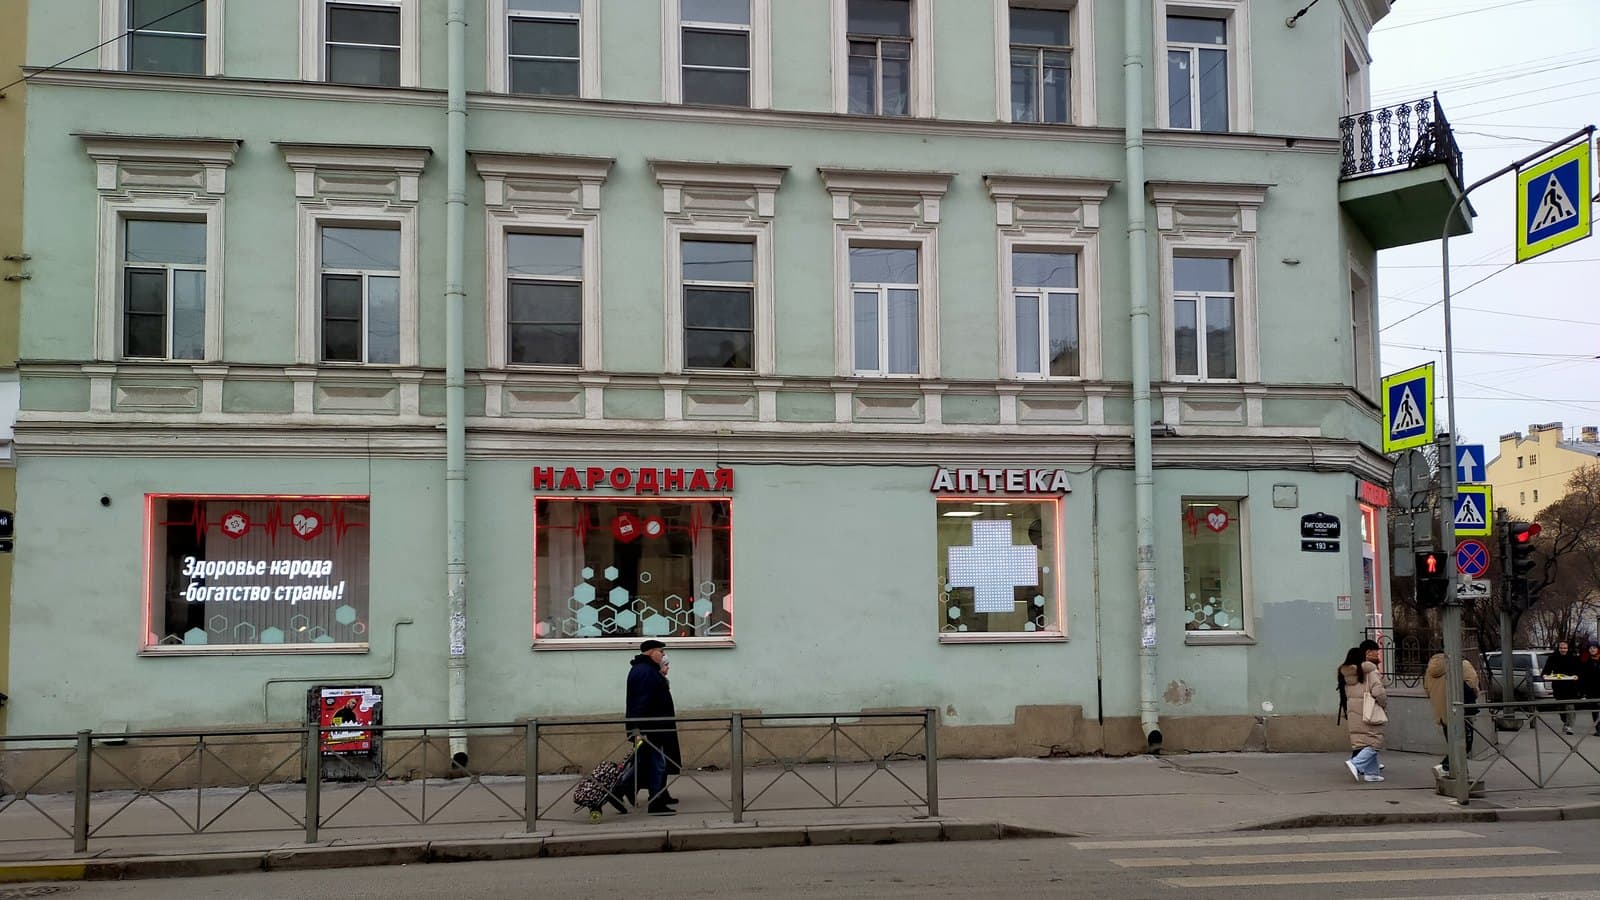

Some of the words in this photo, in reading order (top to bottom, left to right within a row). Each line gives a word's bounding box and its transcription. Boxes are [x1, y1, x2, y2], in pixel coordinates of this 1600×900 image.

[532, 466, 735, 495] НАРОДНАЯ
[930, 468, 1072, 492] АПТЕКА
[182, 556, 265, 580] Здоровье
[270, 559, 332, 579] народа
[179, 582, 270, 602] -богатство
[274, 581, 345, 605] страны!
